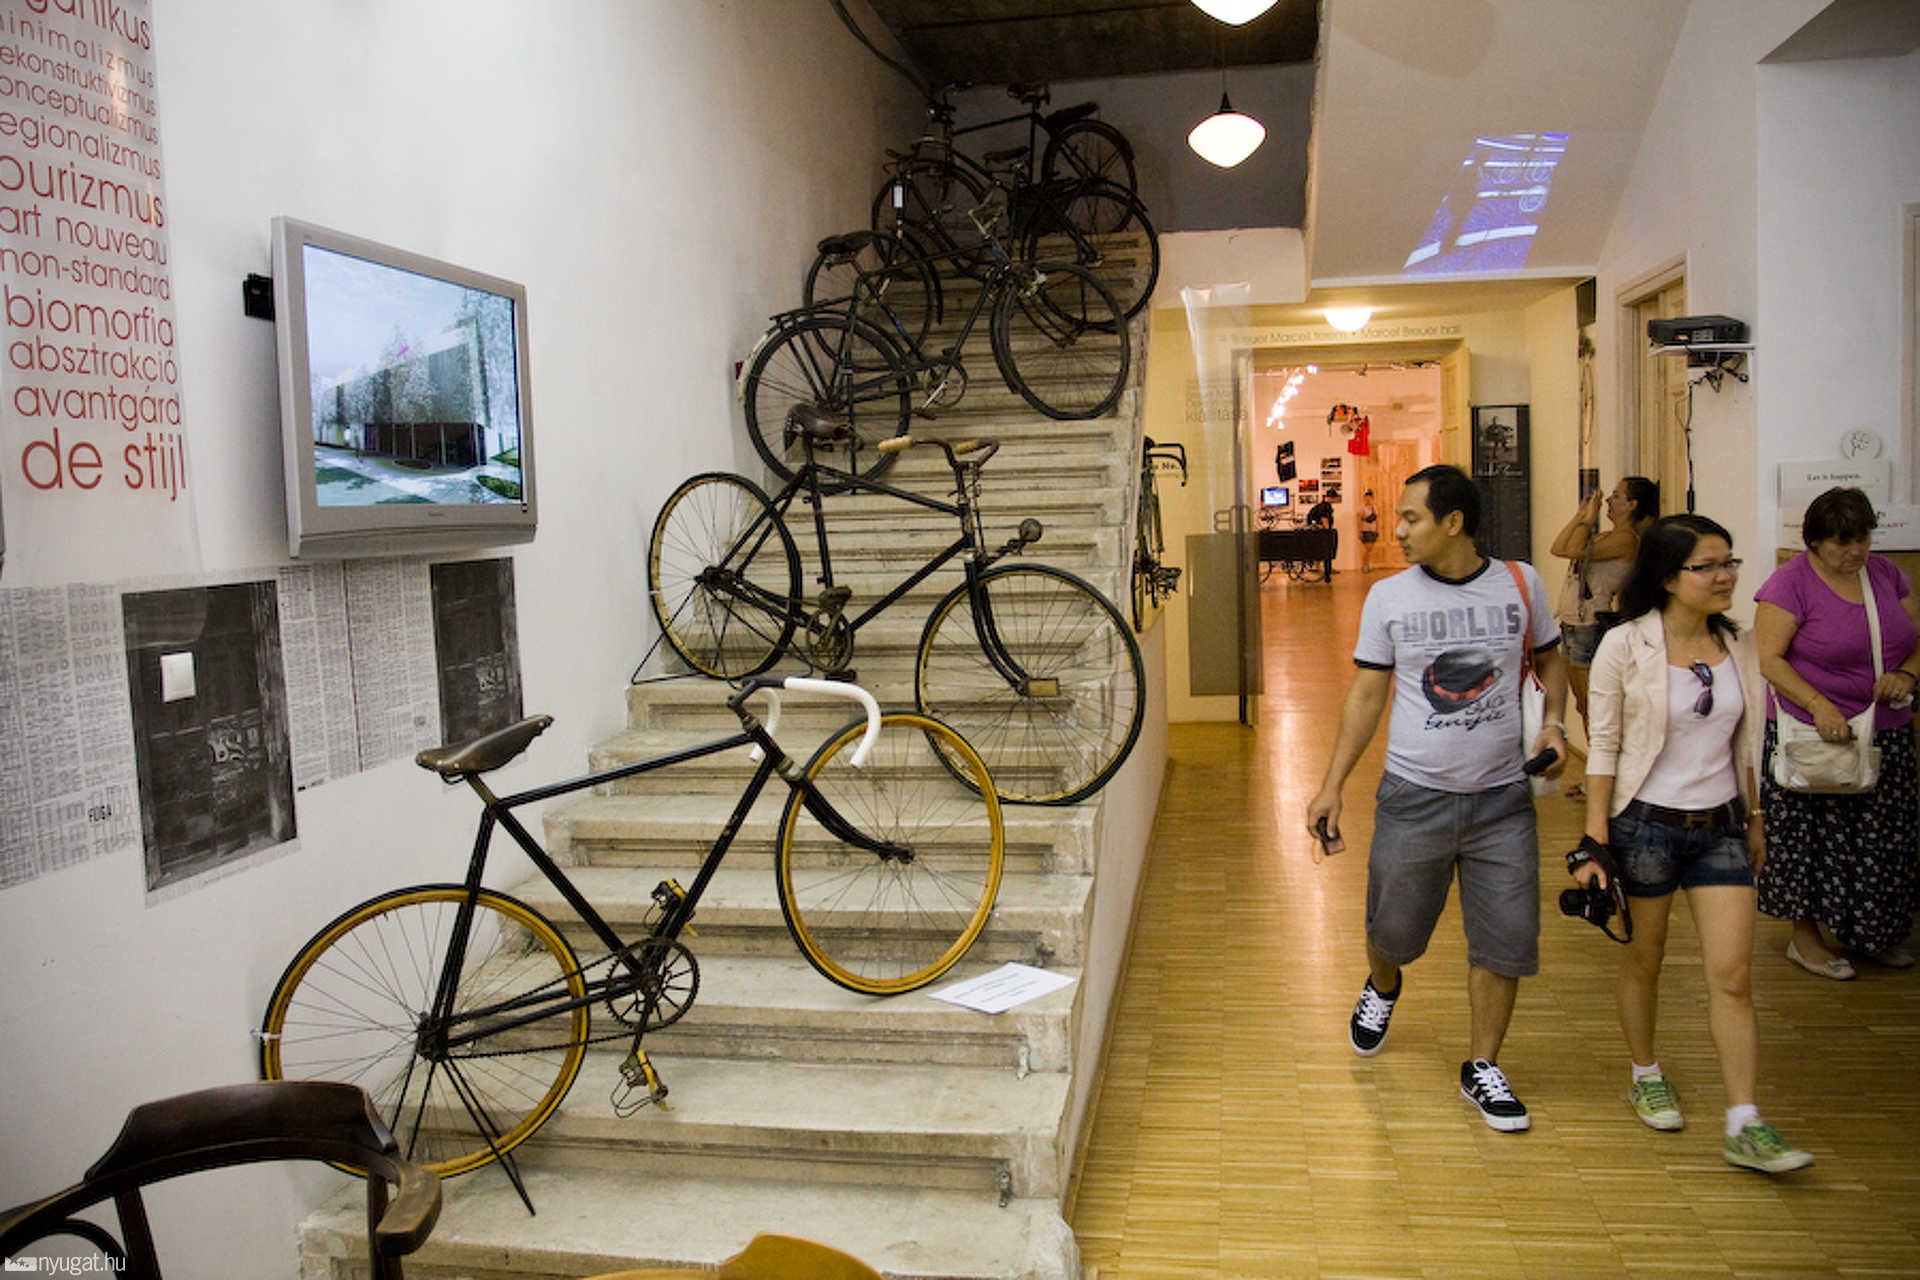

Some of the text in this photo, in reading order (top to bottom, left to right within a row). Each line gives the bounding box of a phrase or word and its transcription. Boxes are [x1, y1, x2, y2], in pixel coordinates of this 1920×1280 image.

[0, 113, 161, 180] egionalizmus
[0, 204, 167, 263] art nouveau
[0, 248, 170, 301] non-standard
[4, 284, 174, 347] biomorfia
[9, 335, 178, 385] absztrakció
[14, 385, 181, 432] avantgárd
[21, 427, 187, 502] de stijl
[1401, 603, 1521, 640] WORLDS
